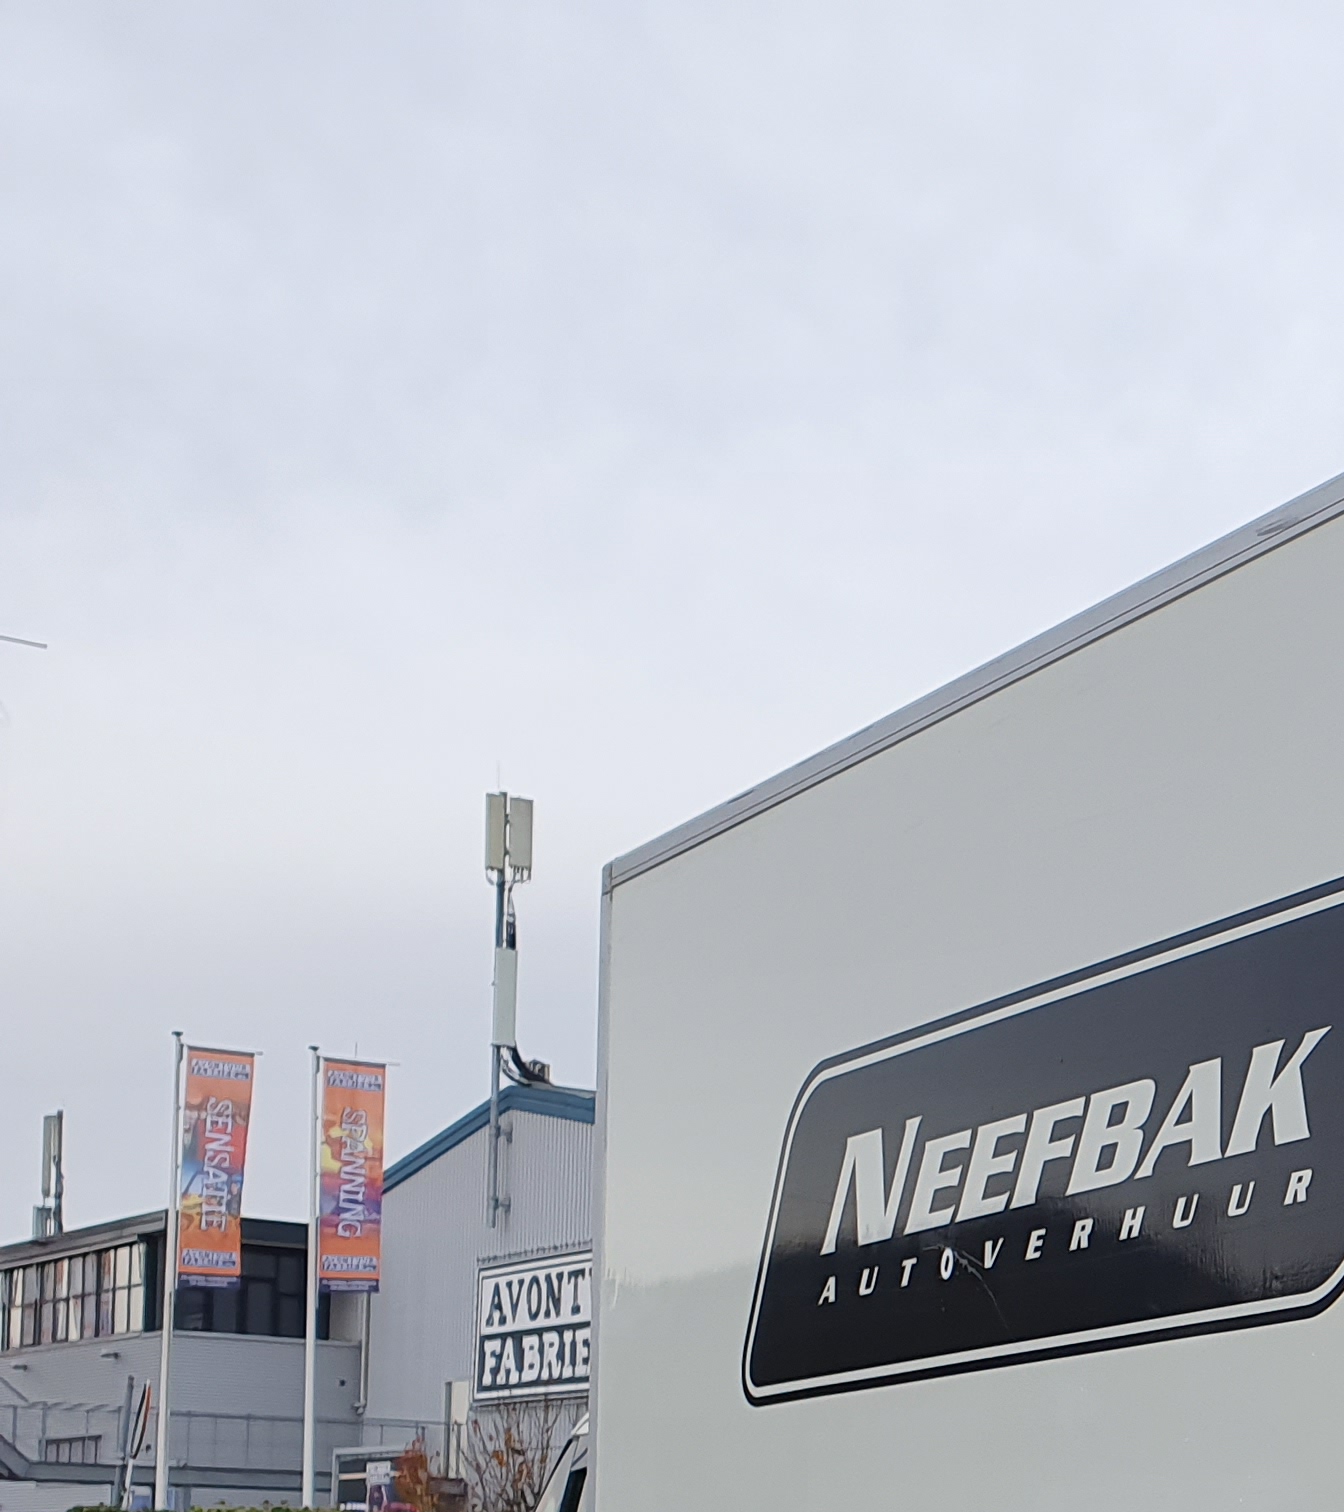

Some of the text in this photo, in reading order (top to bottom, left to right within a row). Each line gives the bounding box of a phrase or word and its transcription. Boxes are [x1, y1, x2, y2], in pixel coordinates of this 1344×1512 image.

[200, 1096, 233, 1233] SENSATIE
[336, 1107, 368, 1238] SPANNING
[820, 1025, 1332, 1255] NEEFBAK
[485, 1267, 592, 1327] AVONT
[817, 1168, 1313, 1306] AUTOVERHUUR
